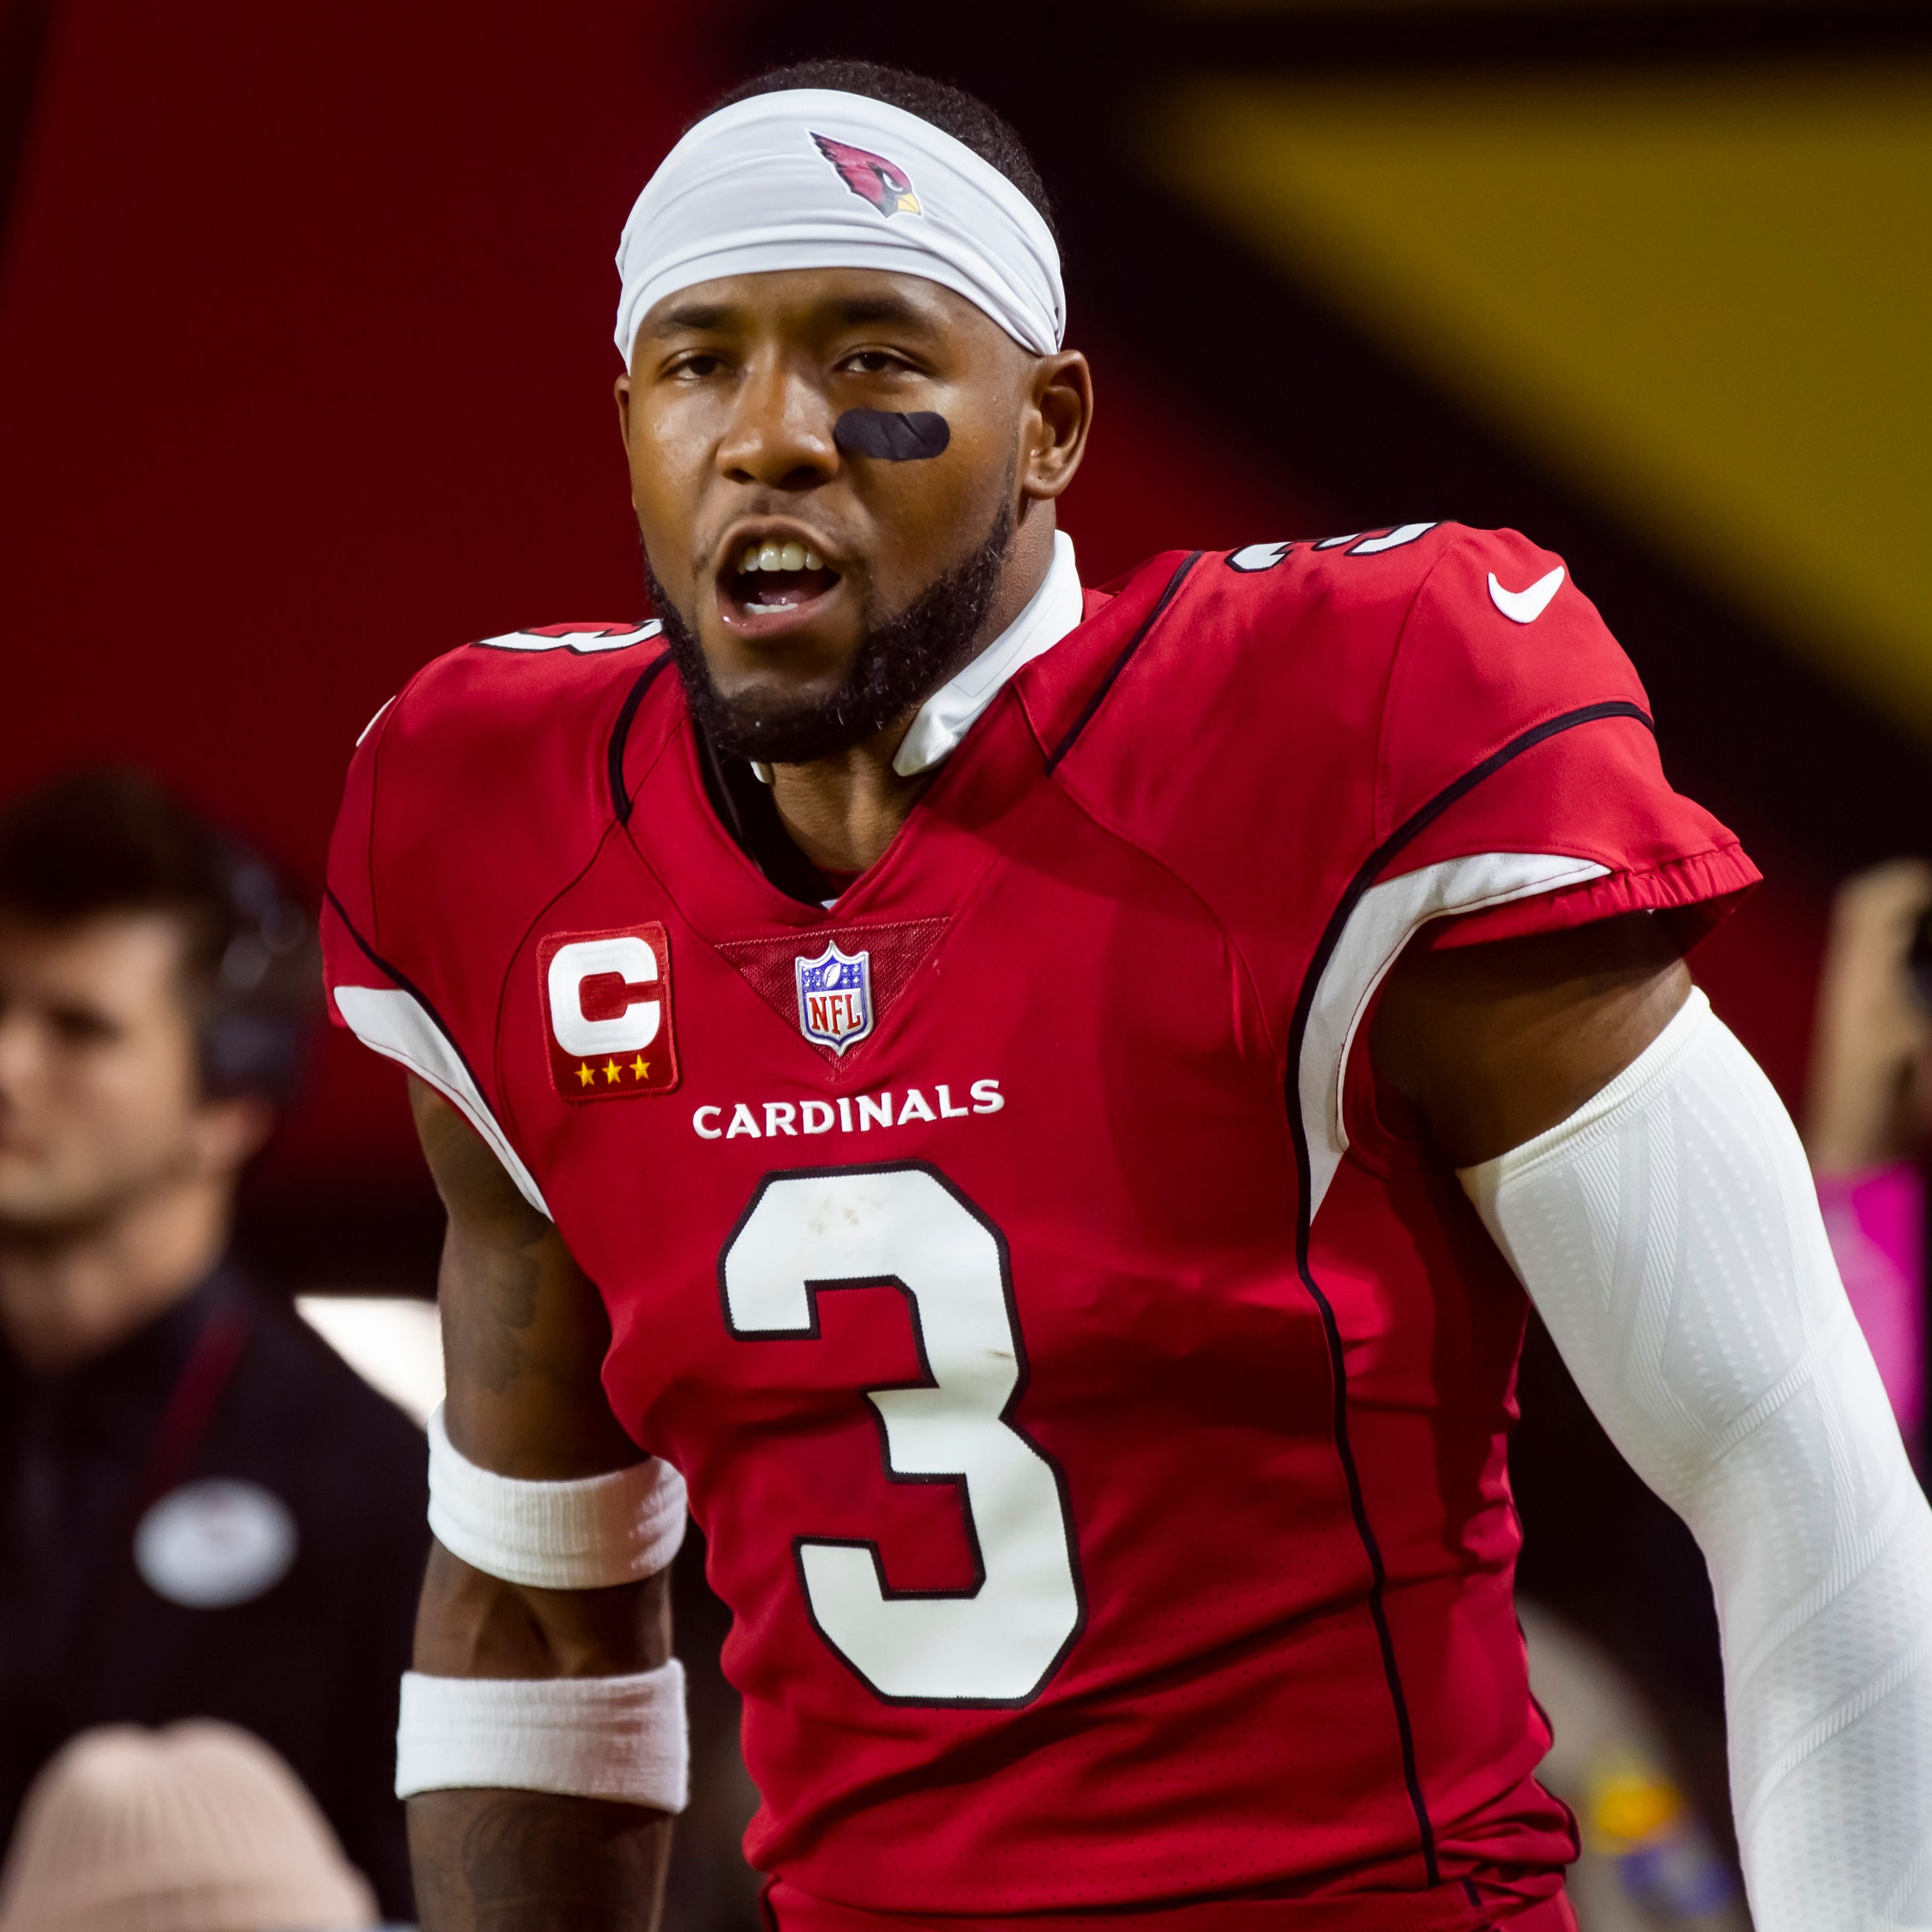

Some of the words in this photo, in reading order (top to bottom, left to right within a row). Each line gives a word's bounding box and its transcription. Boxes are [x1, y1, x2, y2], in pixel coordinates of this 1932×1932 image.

[548, 936, 661, 1057] C
[809, 994, 861, 1034] NFL
[693, 1079, 1005, 1139] CARDINALS
[719, 1163, 1085, 1707] 3
